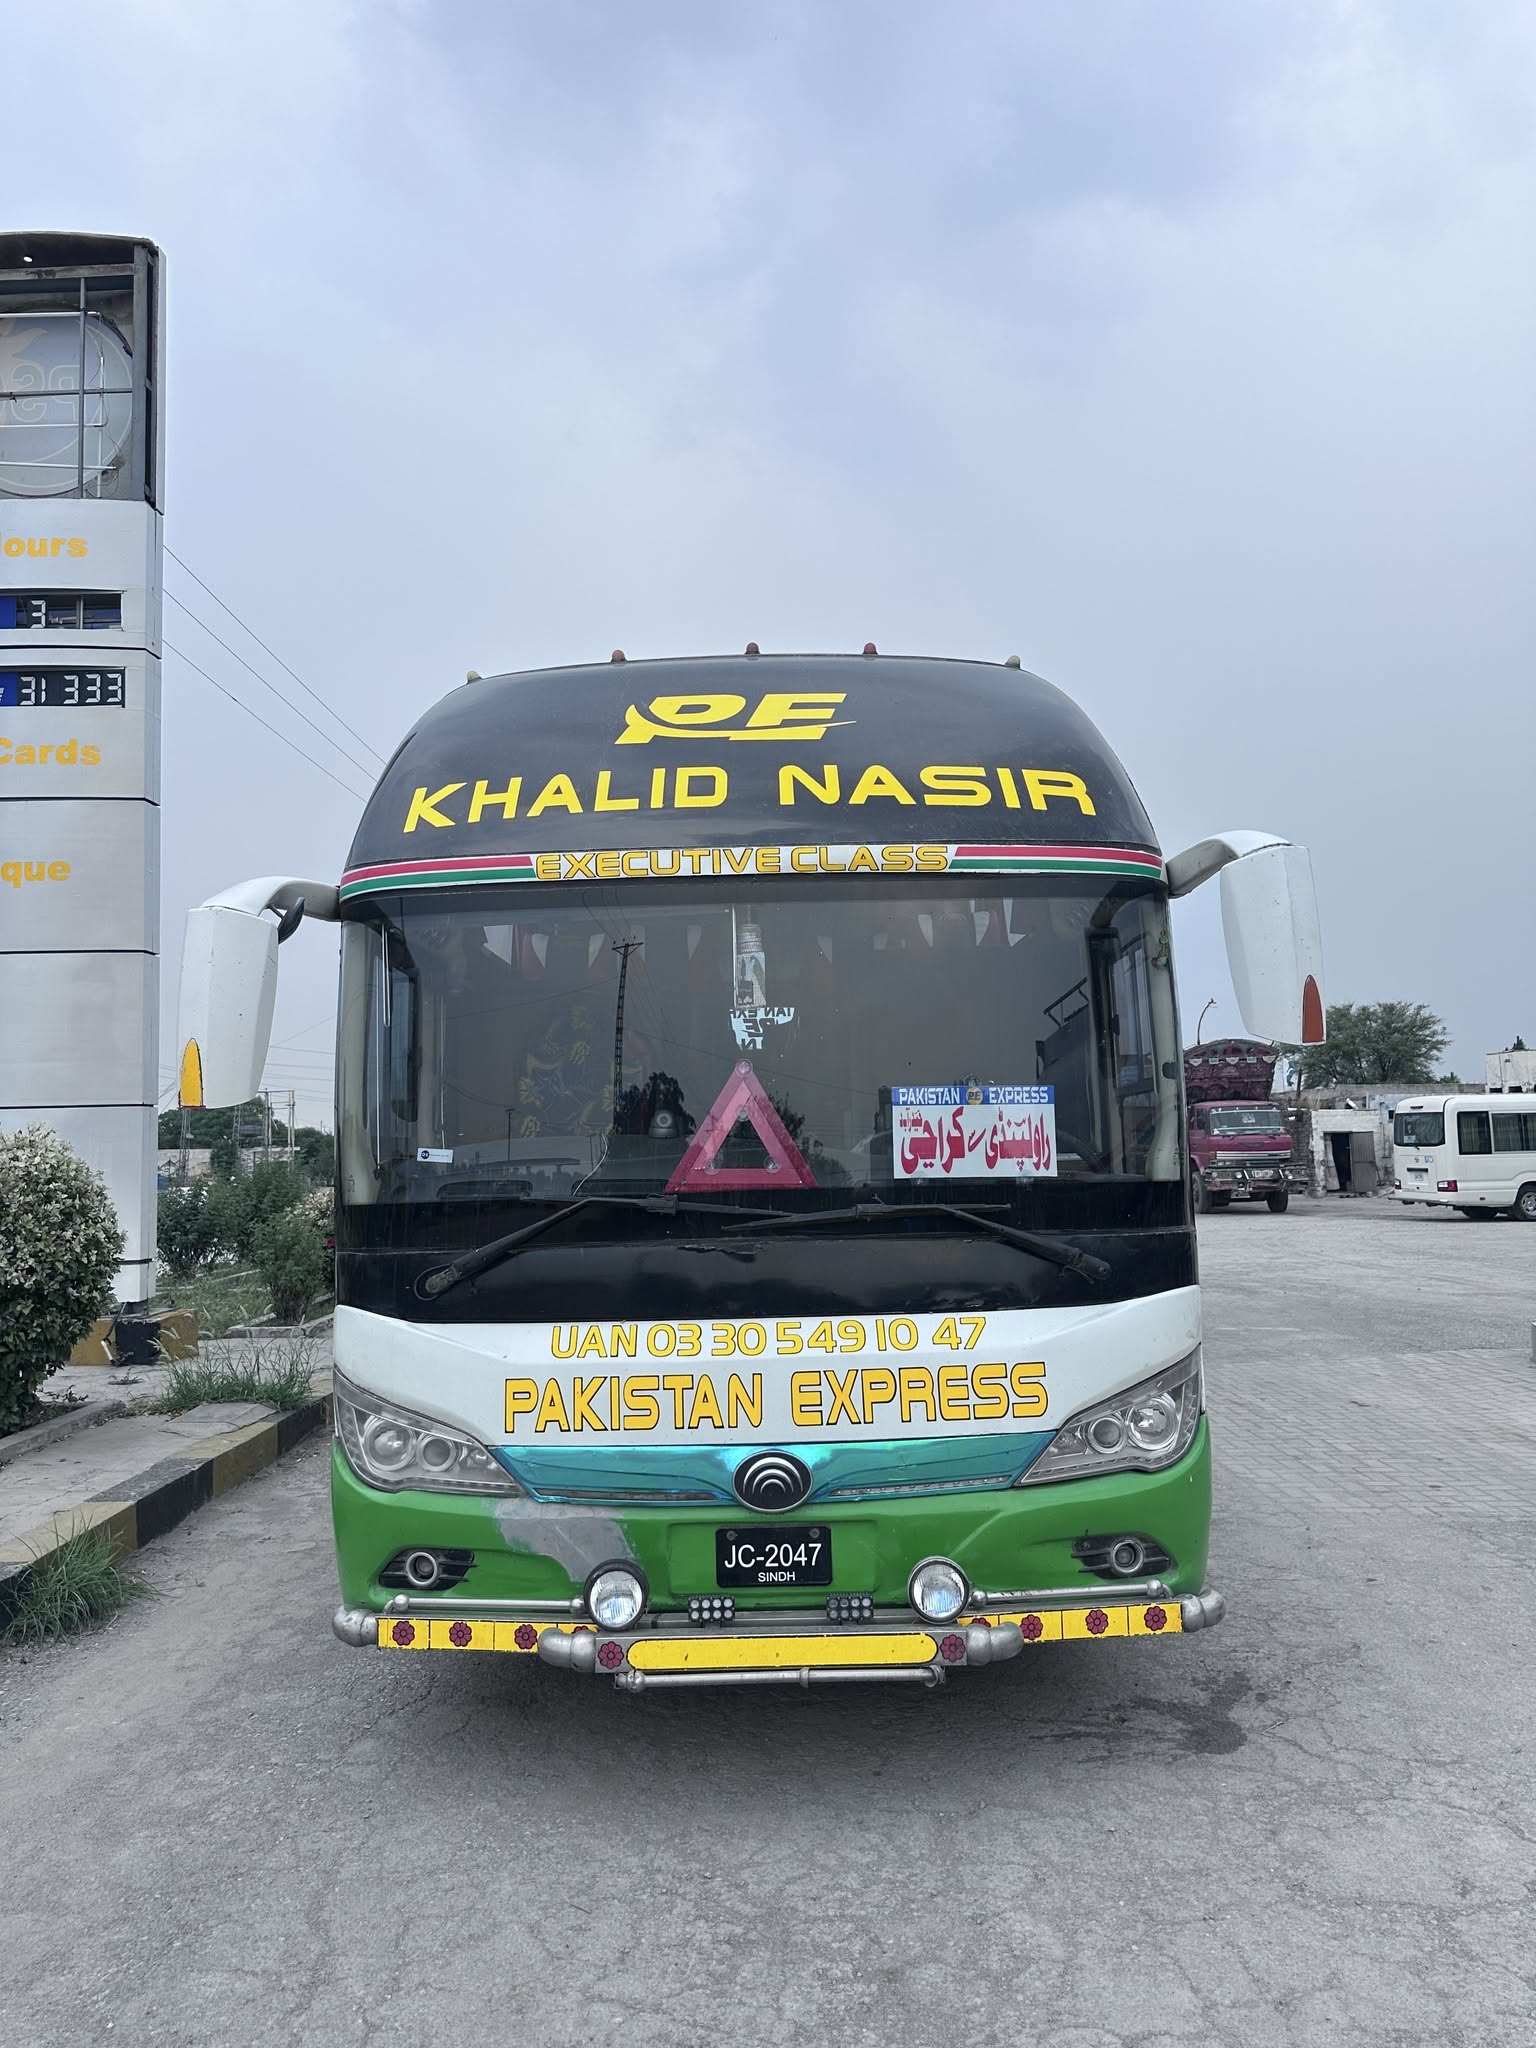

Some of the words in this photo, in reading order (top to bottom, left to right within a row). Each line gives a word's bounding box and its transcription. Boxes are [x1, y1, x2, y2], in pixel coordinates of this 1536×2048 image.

[0, 531, 88, 558] ours
[403, 765, 728, 833] KHALID
[778, 764, 1097, 816] NASIR
[535, 847, 781, 880] EXECUTIVE
[790, 845, 949, 873] CLASS
[988, 1086, 1049, 1104] EXPRESS
[901, 1106, 966, 1175] کراچی
[550, 1325, 638, 1359] UAN
[931, 1316, 987, 1350] 47
[504, 1372, 763, 1433] PAKISTAN
[789, 1361, 1049, 1427] EXPRESS
[724, 1543, 822, 1568] JC-2047
[757, 1571, 796, 1583] SINDH
